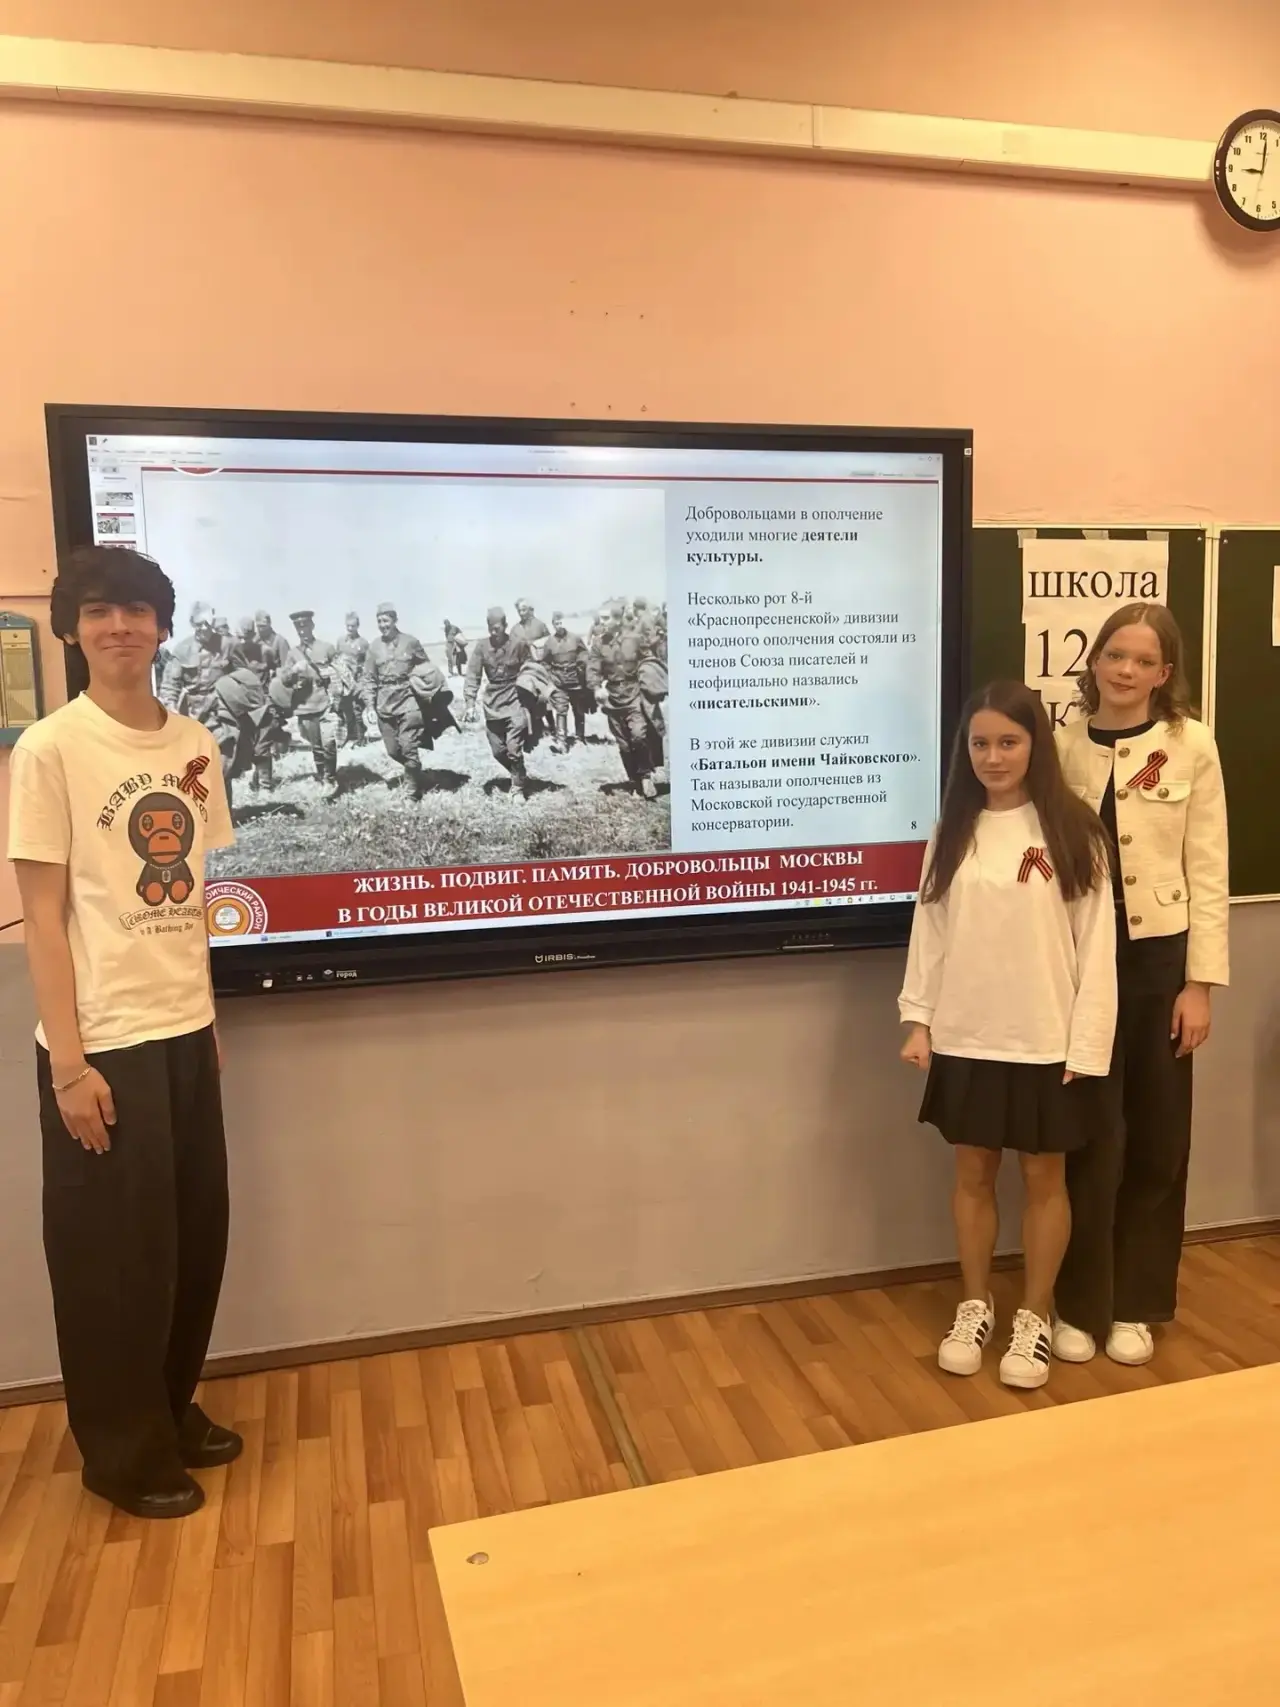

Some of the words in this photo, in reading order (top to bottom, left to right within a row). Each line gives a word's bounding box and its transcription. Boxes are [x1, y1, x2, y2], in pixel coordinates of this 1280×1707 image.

[1245, 135, 1252, 143] 11
[1260, 132, 1267, 141] 12
[1233, 147, 1241, 156] 10
[1228, 164, 1233, 173] 9
[1232, 183, 1237, 192] 8
[1242, 197, 1246, 206] 7
[1256, 204, 1261, 213] 6
[1271, 200, 1277, 209] 5
[685, 505, 796, 523] Добровольцами
[800, 510, 808, 520] в
[811, 509, 884, 521] ополчение
[686, 530, 744, 545] уходили
[748, 530, 798, 542] многие
[801, 530, 859, 543] деятели
[686, 551, 764, 566] культуры.
[1028, 570, 1160, 599] школа
[687, 591, 761, 606] Несколько
[763, 594, 787, 609] рот
[791, 591, 813, 605] 8-й
[687, 611, 841, 630] «Краснопресненской»
[843, 612, 899, 627] дивизии
[687, 635, 760, 651] народного
[763, 633, 835, 647] ополчения
[838, 632, 898, 645] состояли
[901, 632, 917, 644] из
[688, 656, 737, 669] членов
[740, 653, 785, 668] Союза
[788, 652, 857, 667] писателей
[859, 654, 869, 666] и
[1037, 628, 1088, 678] 12
[688, 675, 788, 691] неофициально
[792, 674, 859, 688] назвались
[688, 696, 821, 711] «писательскими».
[690, 737, 701, 751] В
[704, 736, 735, 751] этой
[738, 738, 757, 750] же
[761, 735, 816, 750] дивизии
[819, 734, 870, 749] служил
[690, 756, 767, 772] «Батальон
[771, 756, 816, 769] имени
[819, 751, 921, 767] Чайковского».
[691, 777, 715, 792] Так
[718, 776, 782, 790] называли
[785, 773, 863, 790] ополченцев
[866, 773, 882, 785] из
[691, 795, 773, 812] Московской
[776, 791, 888, 809] государственной
[691, 816, 795, 832] консерватории.
[910, 820, 918, 831] 8
[353, 875, 435, 894] ЖИЗНЬ.
[440, 869, 527, 890] ПОДВИГ.
[531, 864, 621, 884] ПАМЯТЬ.
[625, 855, 771, 881] ДОБРОВОЛЬЦЫ
[779, 850, 864, 869] МОСКВЫ
[205, 886, 254, 902] ОИЧЕСКИЙ
[337, 907, 352, 924] В
[356, 903, 418, 924] ГОДЫ
[423, 893, 524, 918] ВЕЛИКОЙ
[528, 884, 701, 911] ОТЕЧЕСТВЕННОЙ
[705, 880, 775, 901] ВОЙНЫ
[781, 877, 856, 896] 1941-1945
[860, 880, 878, 892] гг.
[544, 953, 574, 962] IRBIS
